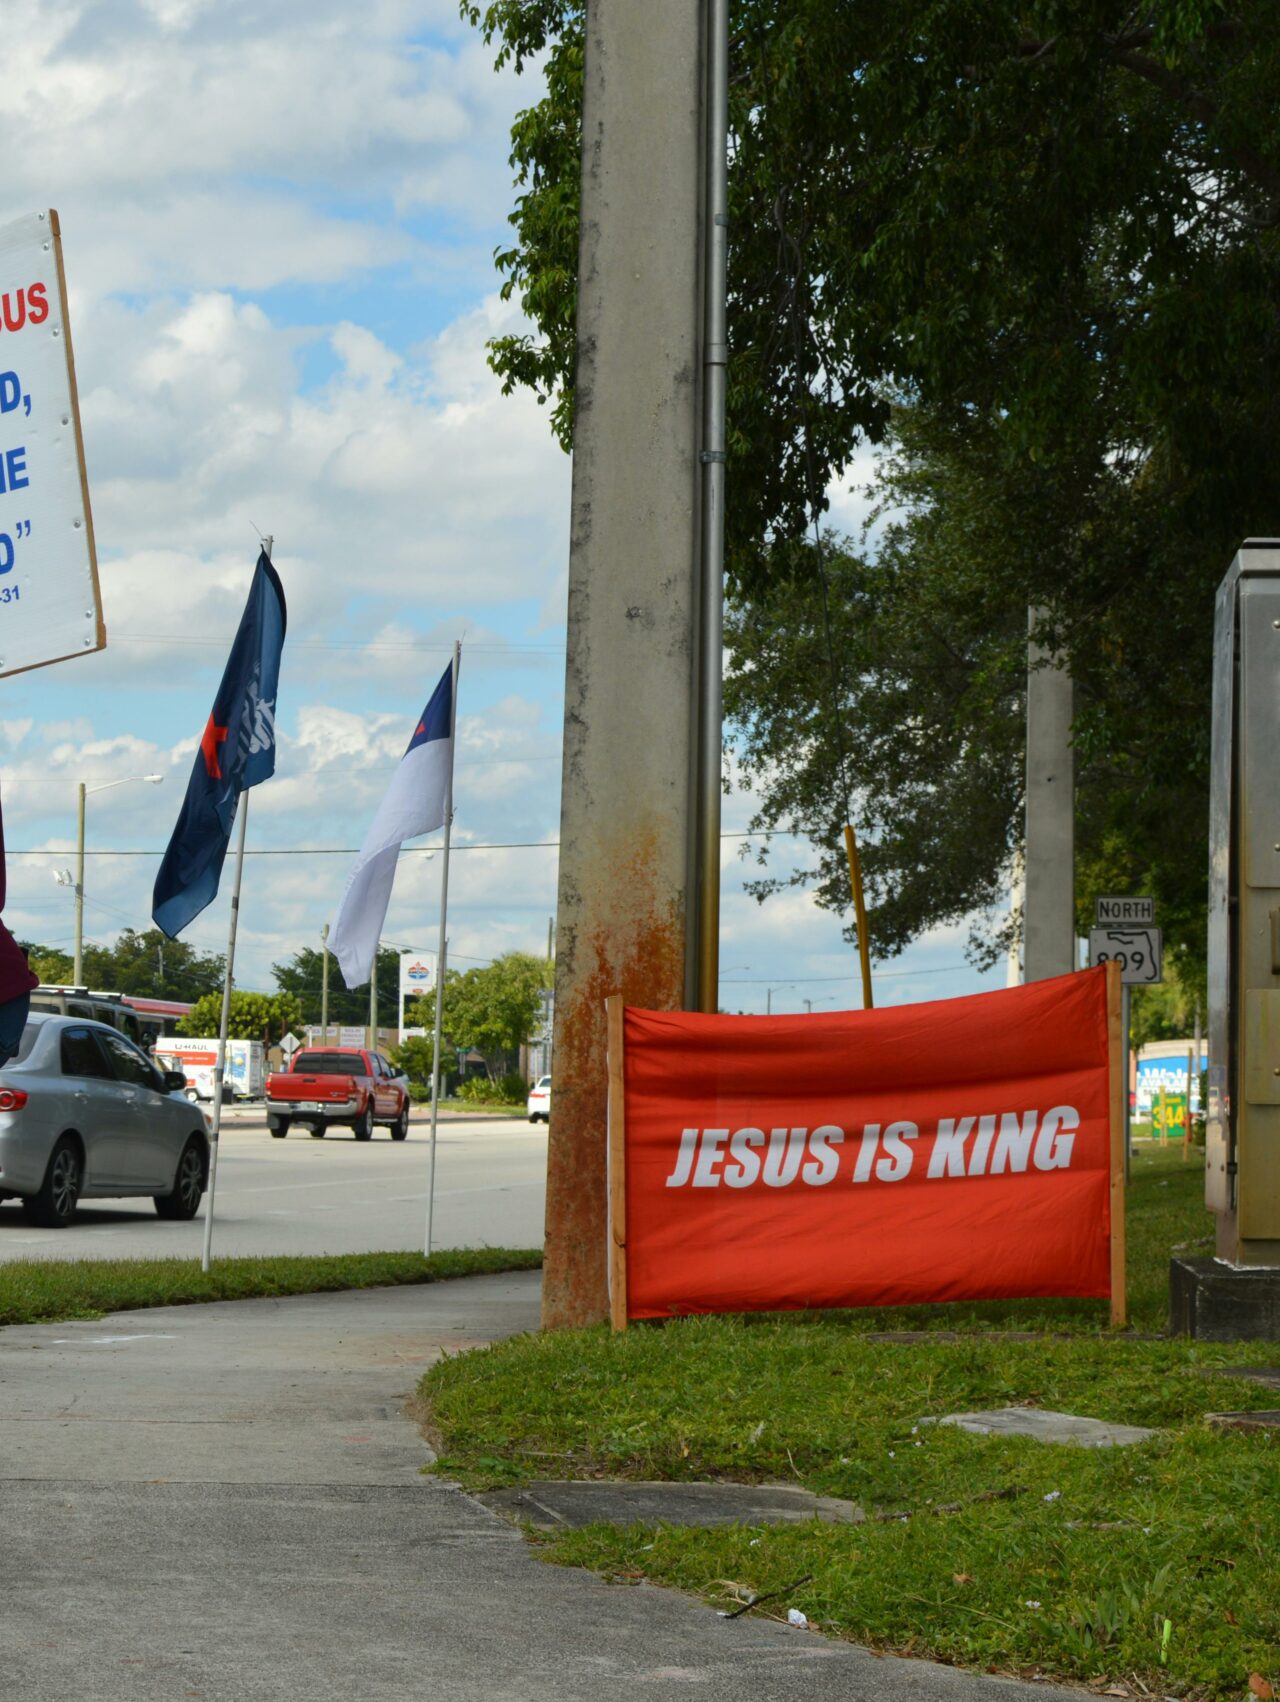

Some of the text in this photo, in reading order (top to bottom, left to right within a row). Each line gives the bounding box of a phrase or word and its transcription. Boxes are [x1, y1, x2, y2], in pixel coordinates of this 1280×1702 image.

[1099, 901, 1151, 919] NORTH
[666, 1106, 1080, 1188] JESUS IS KING
